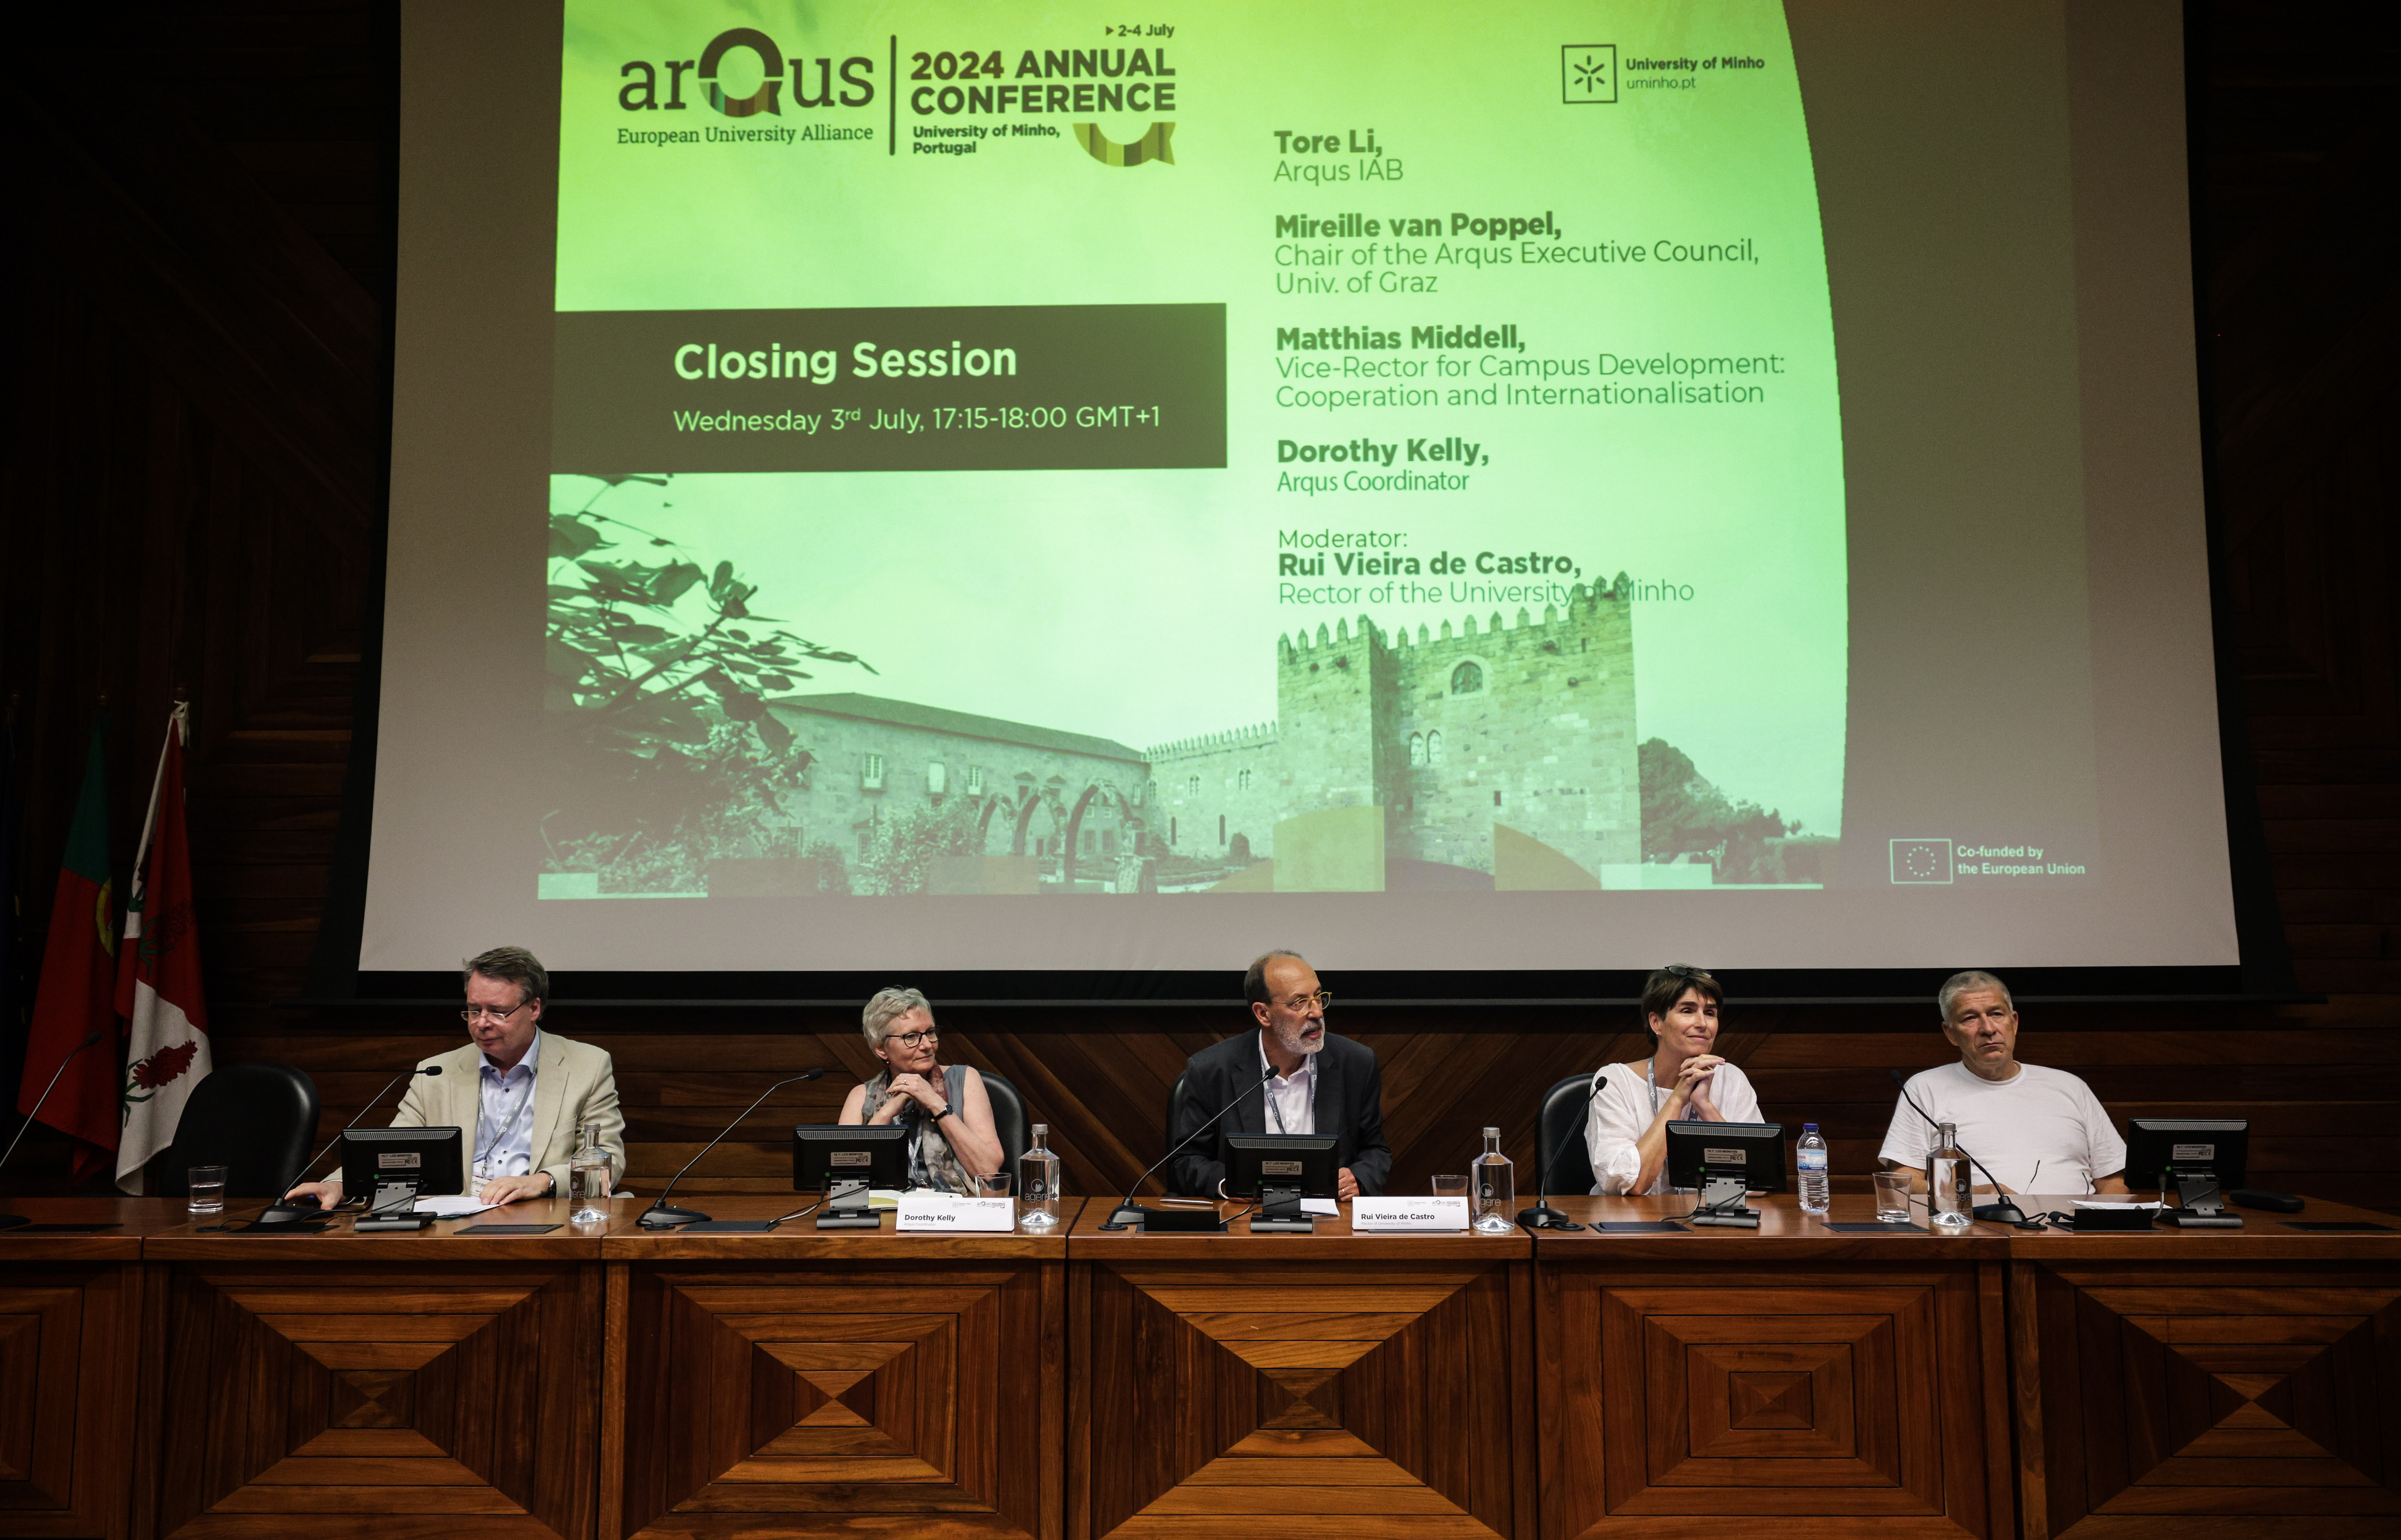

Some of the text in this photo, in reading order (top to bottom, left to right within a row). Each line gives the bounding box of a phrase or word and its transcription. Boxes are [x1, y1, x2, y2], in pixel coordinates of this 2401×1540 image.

[1118, 24, 1175, 38] 2-4 July
[911, 48, 1175, 81] 2024 ANNUAL
[1626, 56, 1765, 72] University of Minho
[1627, 76, 1696, 90] uminho.pt
[911, 83, 1175, 116] CONFERENCE
[618, 124, 874, 147] European University Alliance
[913, 124, 1060, 140] University of Minho,
[1274, 128, 1383, 158] Tore Li,
[913, 141, 977, 156] Portugal
[1274, 159, 1403, 187] Arqus IAB
[1276, 211, 1562, 241] Mireille van Poppel,
[1275, 238, 1759, 268] Chair of the Arqus Executive Council,
[1276, 270, 1438, 294] Univ. of Graz
[1277, 324, 1525, 354] Matthias Middell,
[675, 341, 1016, 384] Closing Session
[1276, 352, 1785, 381] Vice-Rector for Campus Development:
[1276, 380, 1764, 412] Cooperation and Internationalisation
[673, 406, 1158, 435] Wednesday 3rd July, 17:15-18:00 GMT+1
[1278, 436, 1489, 467] Dorothy Kelly,
[1277, 469, 1470, 497] Arqus Coordinator
[1279, 528, 1407, 548] Moderator:
[1279, 550, 1581, 579] Rui Vieira de Castro,
[1280, 579, 1694, 607] Rector of the University of Minho
[1957, 845, 2043, 860] Co-funded by
[1958, 862, 2085, 877] the European Union
[1025, 1193, 1049, 1203] agere
[1479, 1198, 1501, 1208] gere
[1954, 1193, 1971, 1203] gere
